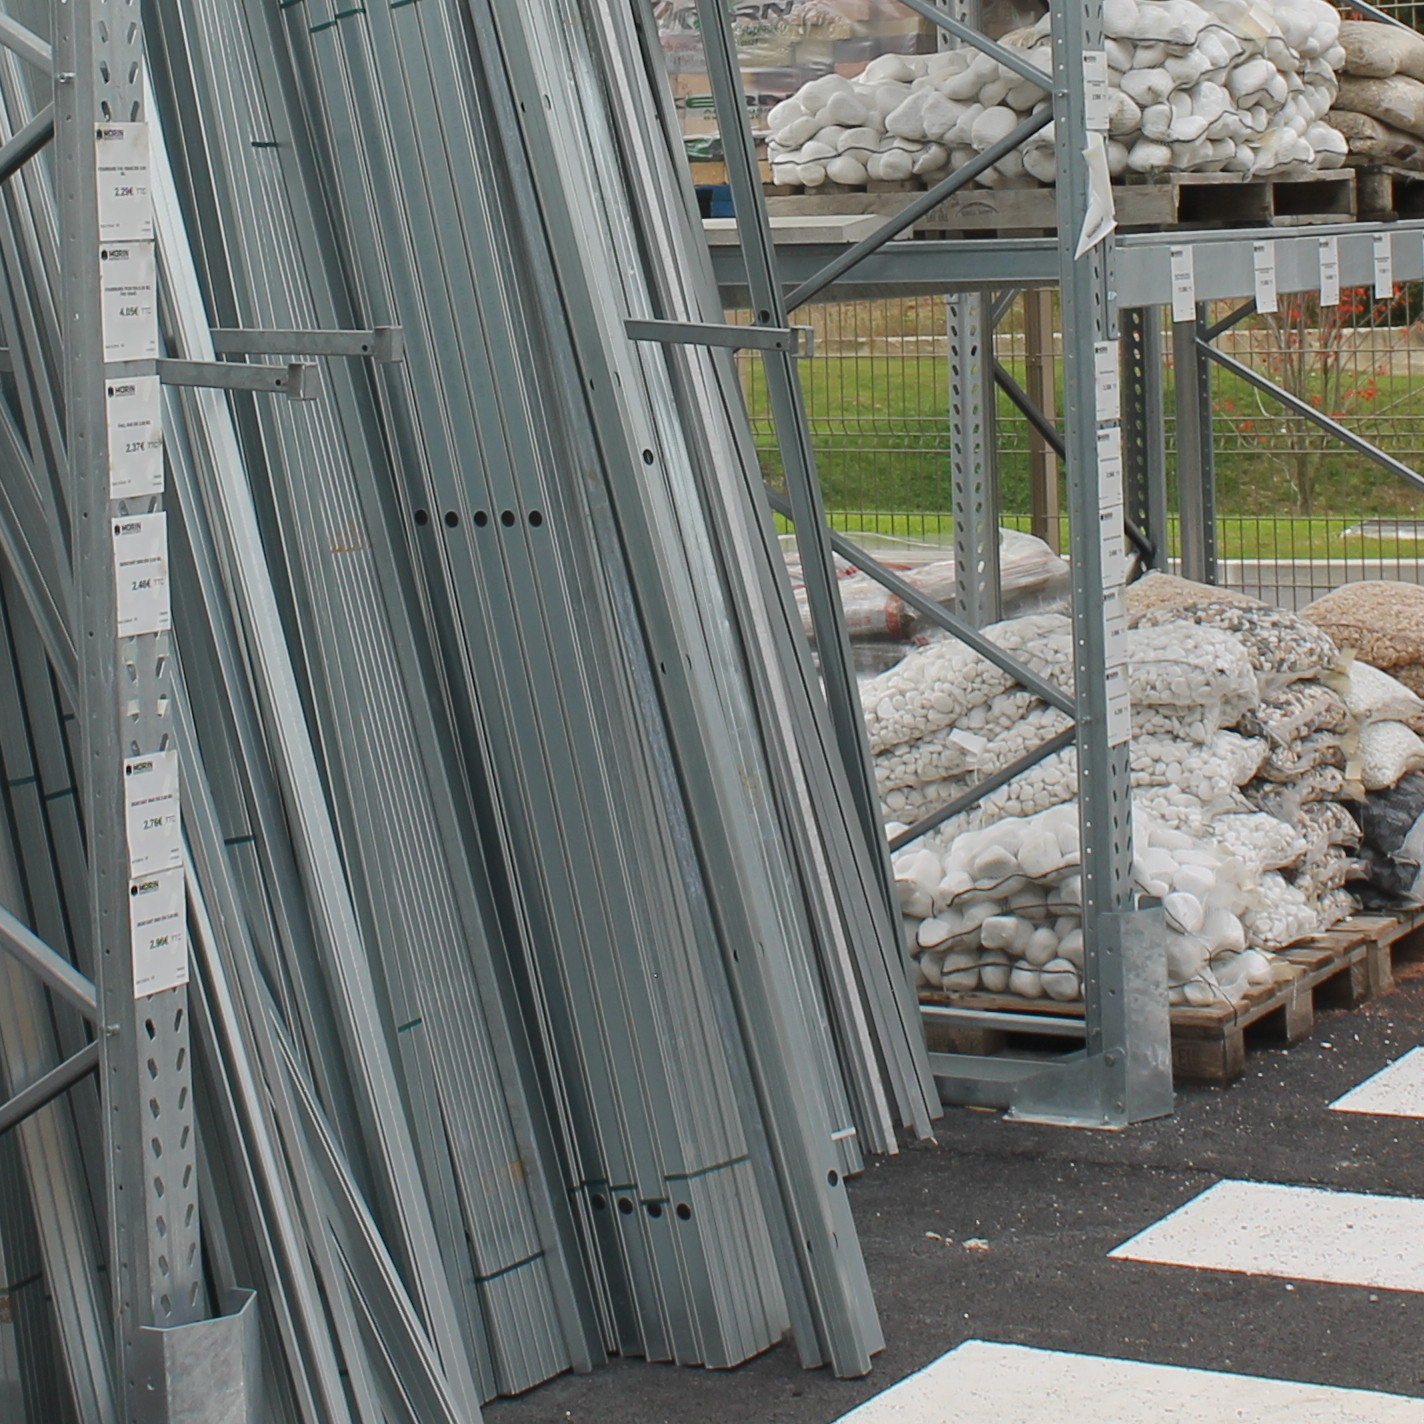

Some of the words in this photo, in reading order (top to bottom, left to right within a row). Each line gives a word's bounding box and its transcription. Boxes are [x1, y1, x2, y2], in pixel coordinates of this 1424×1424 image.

[109, 249, 129, 257] MORIN
[115, 385, 136, 393] MORIN
[125, 442, 145, 453] 2.37€
[122, 523, 142, 532] MORIN
